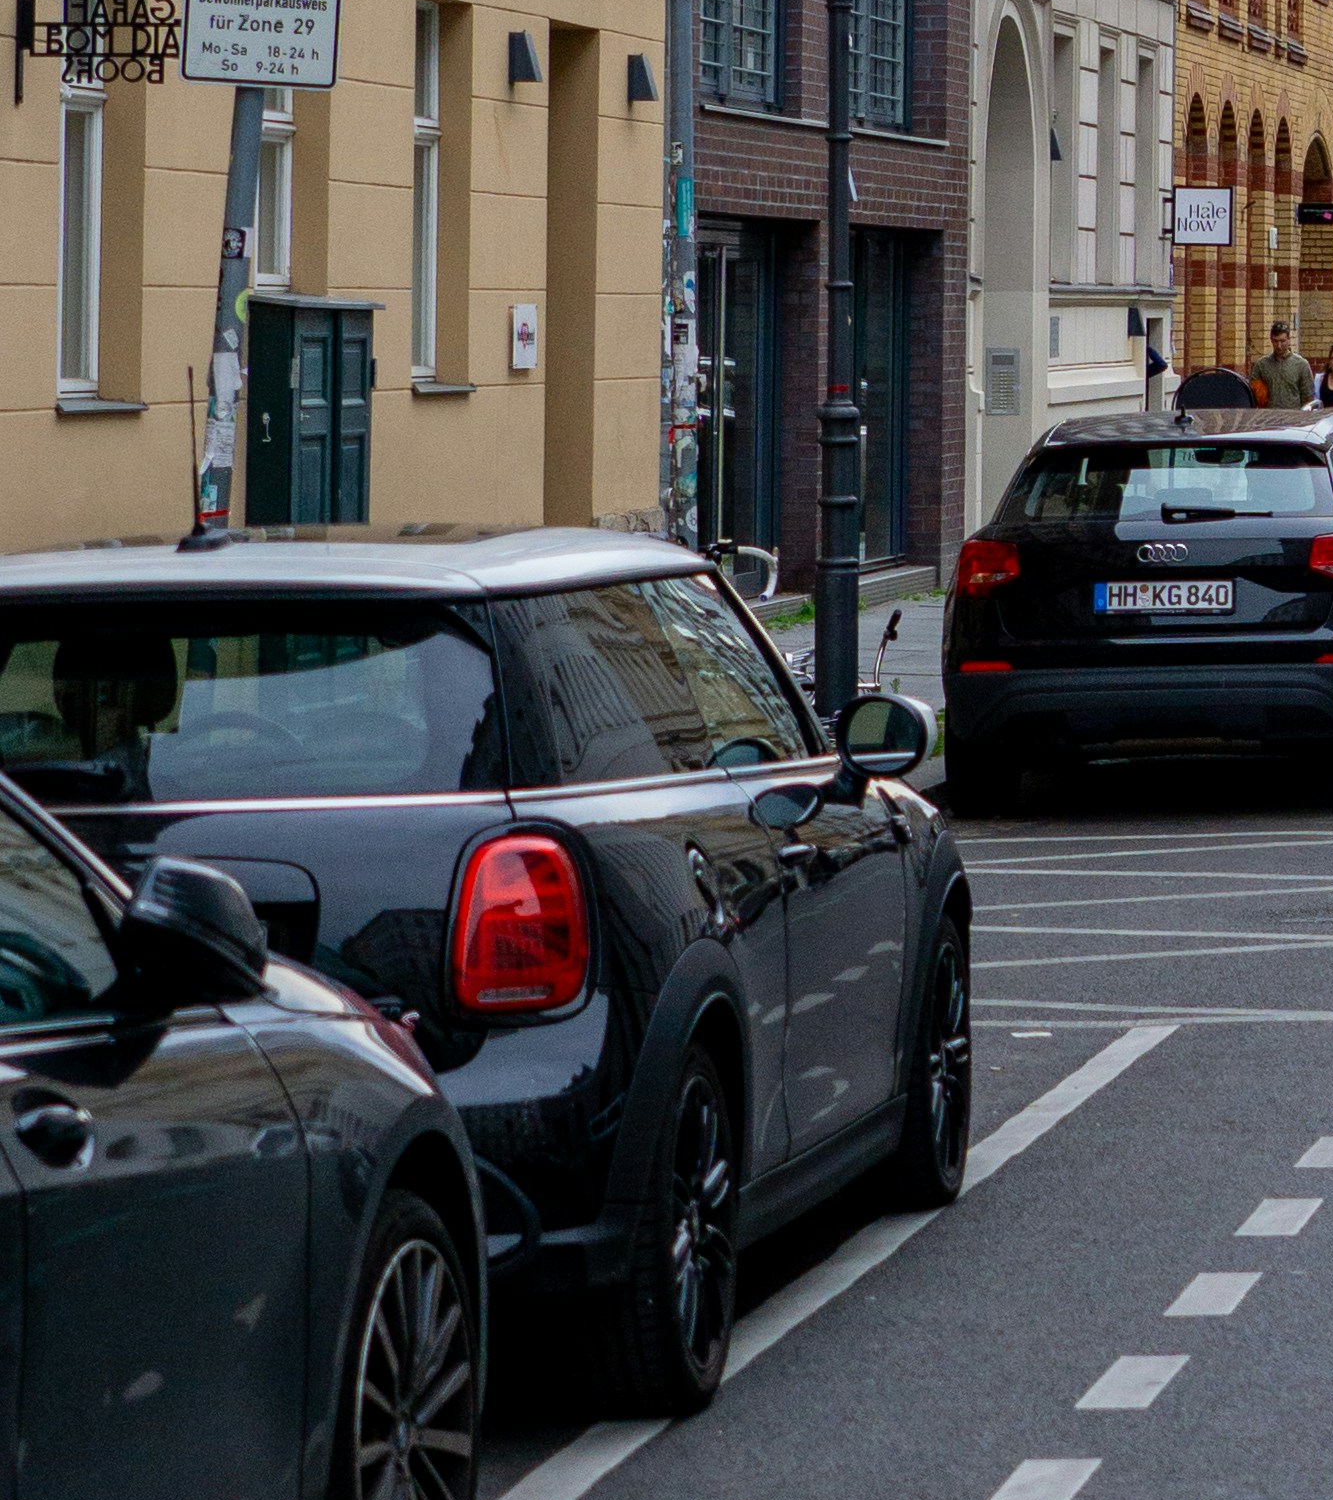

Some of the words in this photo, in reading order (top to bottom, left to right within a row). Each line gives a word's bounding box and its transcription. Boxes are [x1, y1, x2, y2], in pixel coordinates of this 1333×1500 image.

[209, 14, 234, 32] für
[237, 14, 284, 34] Zone
[293, 18, 316, 36] 29
[46, 25, 114, 55] BOM
[132, 25, 180, 56] DIA
[267, 45, 306, 60] 18-24
[311, 47, 320, 62] h
[221, 59, 239, 73] So
[256, 61, 285, 75] 9-24
[290, 62, 299, 76] h
[1188, 201, 1227, 220] Hale
[1108, 584, 1138, 607] HH
[1151, 584, 1182, 607] KG
[1186, 584, 1229, 607] 840
